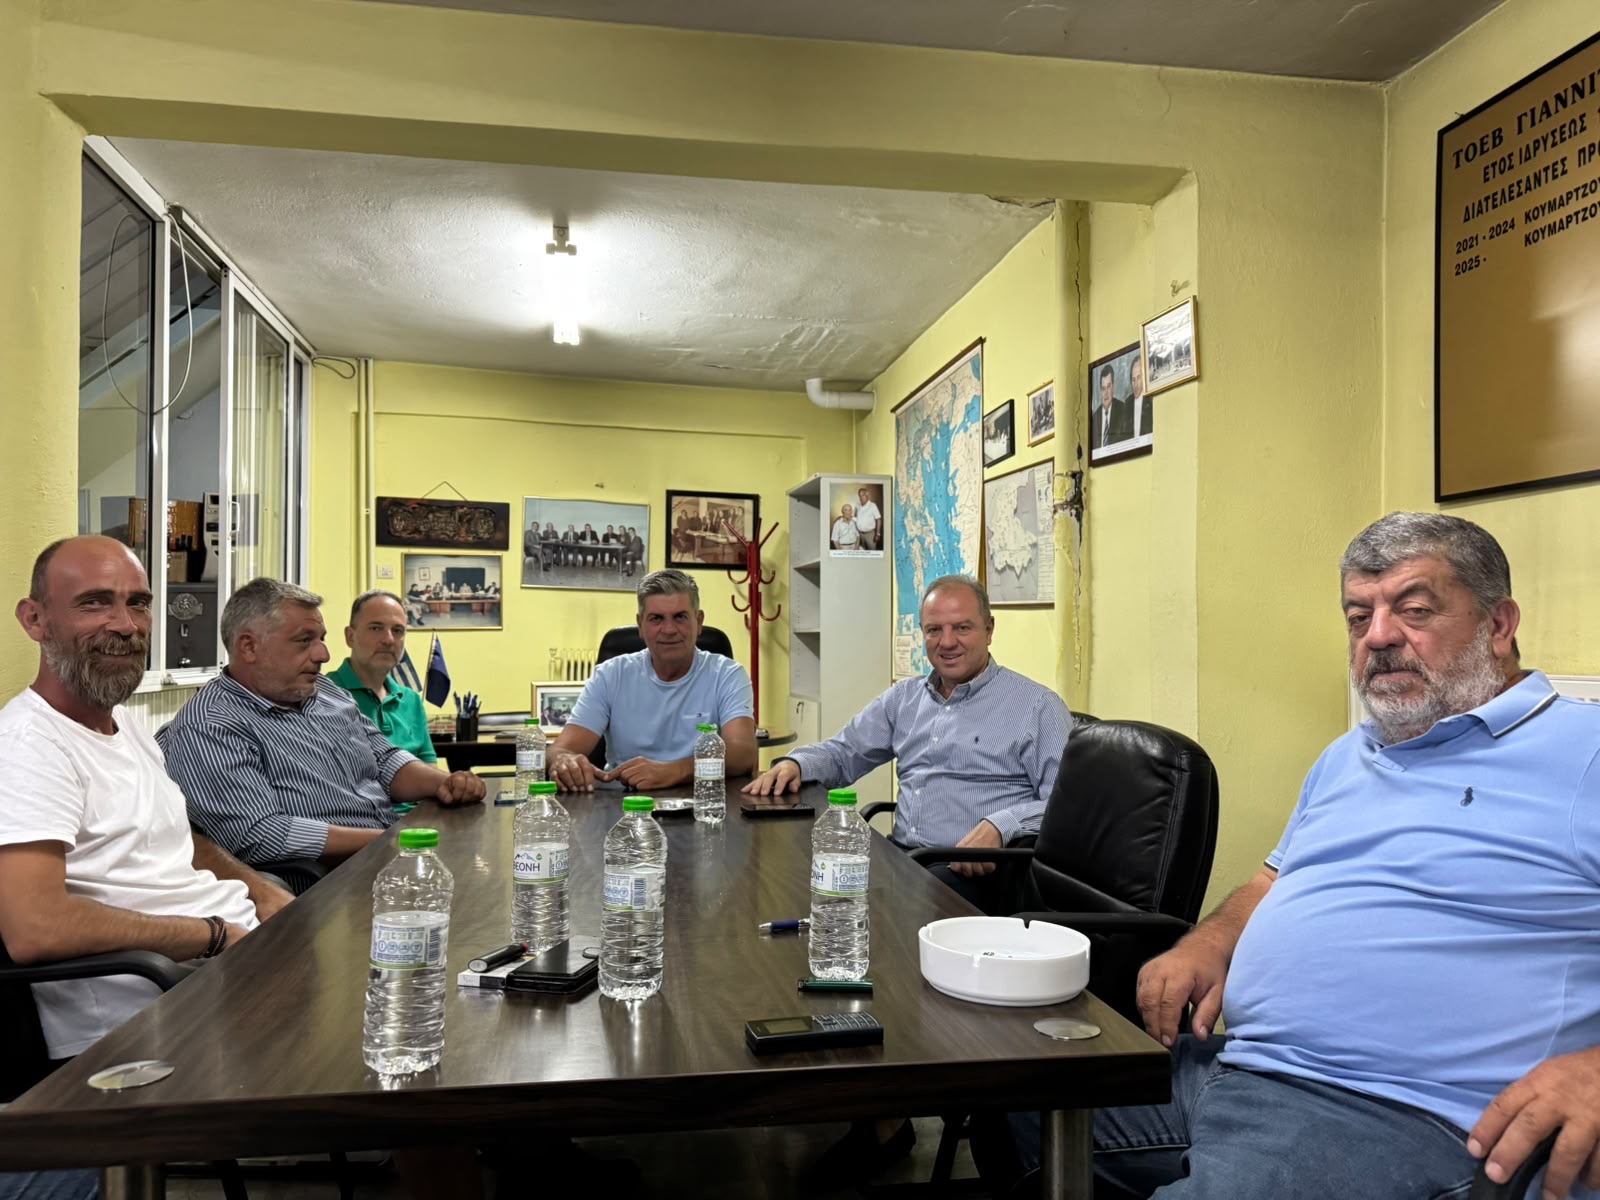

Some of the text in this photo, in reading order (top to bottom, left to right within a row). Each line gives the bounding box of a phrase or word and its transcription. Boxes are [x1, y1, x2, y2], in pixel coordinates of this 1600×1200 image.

[1453, 68, 1600, 170] ΤΟΕΒ ΓΙΑΝΝΙ
[1483, 112, 1587, 184] ΕΤΟΣ ΙΔΡΥΣΕΩΣ
[1455, 233, 1479, 255] 2021
[1488, 217, 1516, 241] 2024
[1524, 177, 1600, 224] ΚΟΥΜΑΡΤΖΟ
[1463, 140, 1600, 223] ΔΙΑΤΕΛΕΣΑΝΤΕΣ ΠΡ
[1454, 255, 1480, 276] 2025
[1524, 200, 1600, 247] ΚΟΥΜΑΡΤΖΟ
